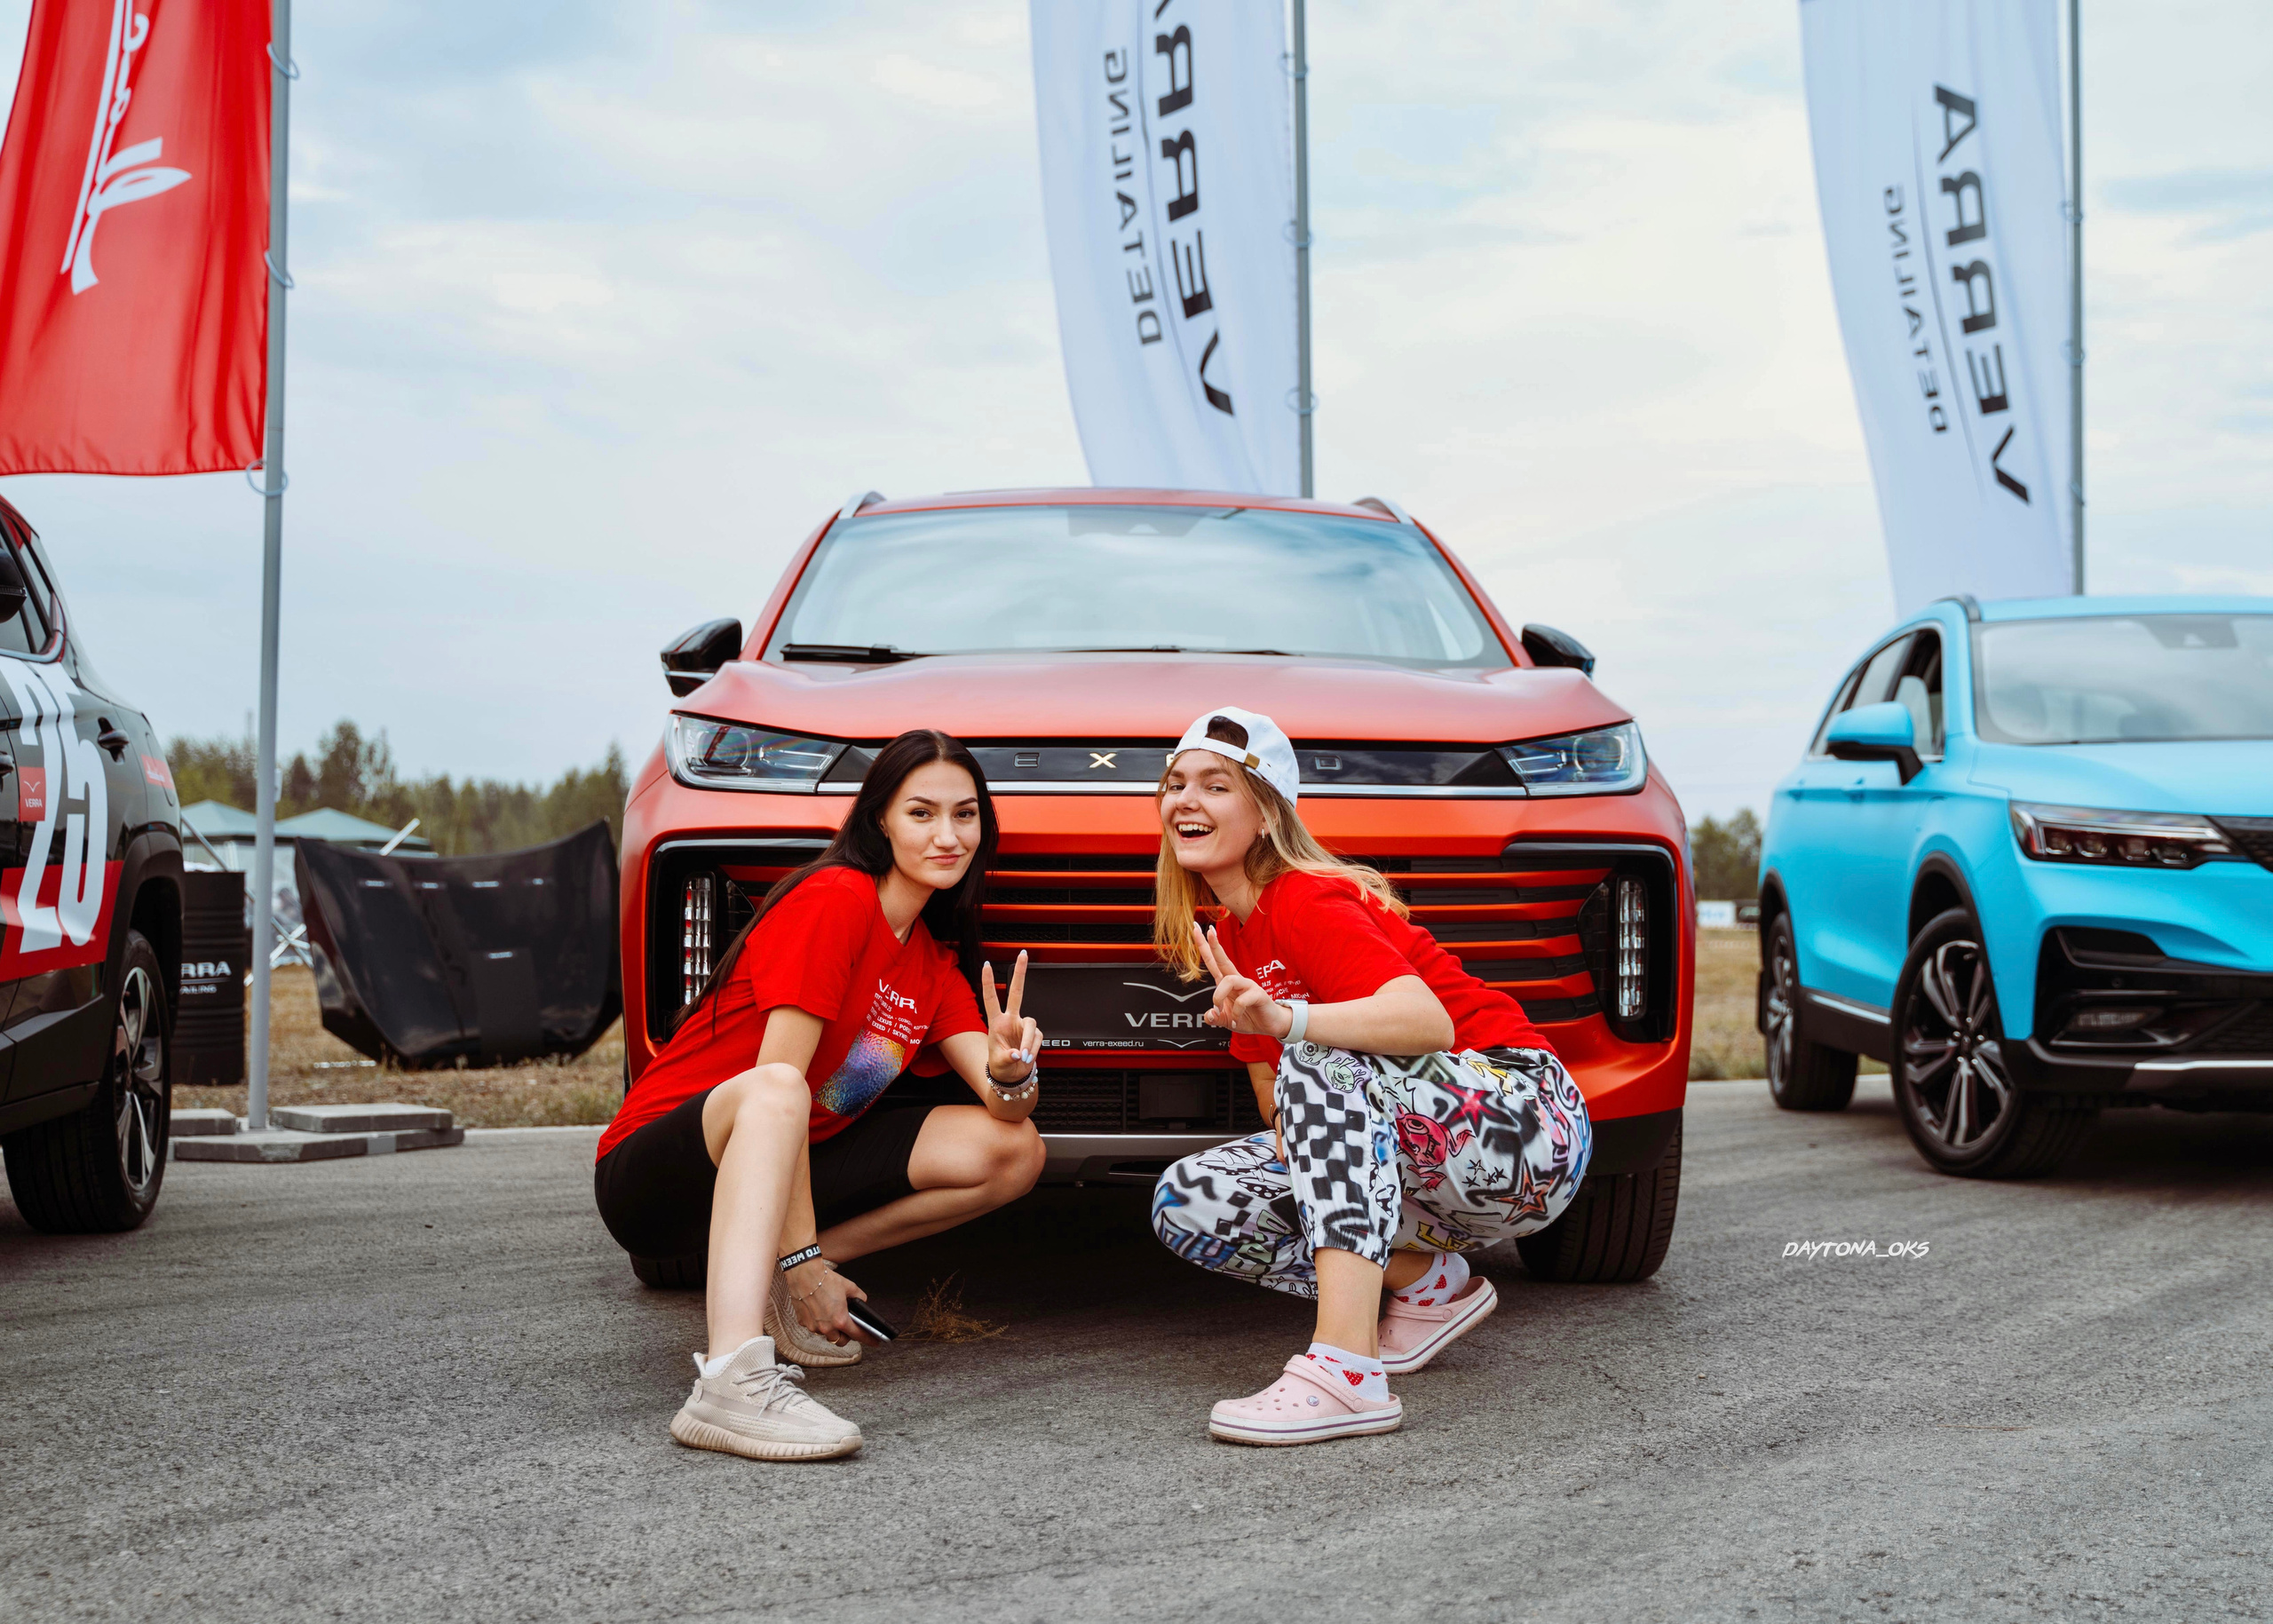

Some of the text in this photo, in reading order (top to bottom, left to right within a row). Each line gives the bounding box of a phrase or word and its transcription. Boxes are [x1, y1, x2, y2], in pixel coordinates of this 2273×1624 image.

[0, 655, 108, 954] 25
[25, 797, 44, 808] VERRA
[180, 961, 232, 978] RRA
[876, 1016, 892, 1026] LEXUS
